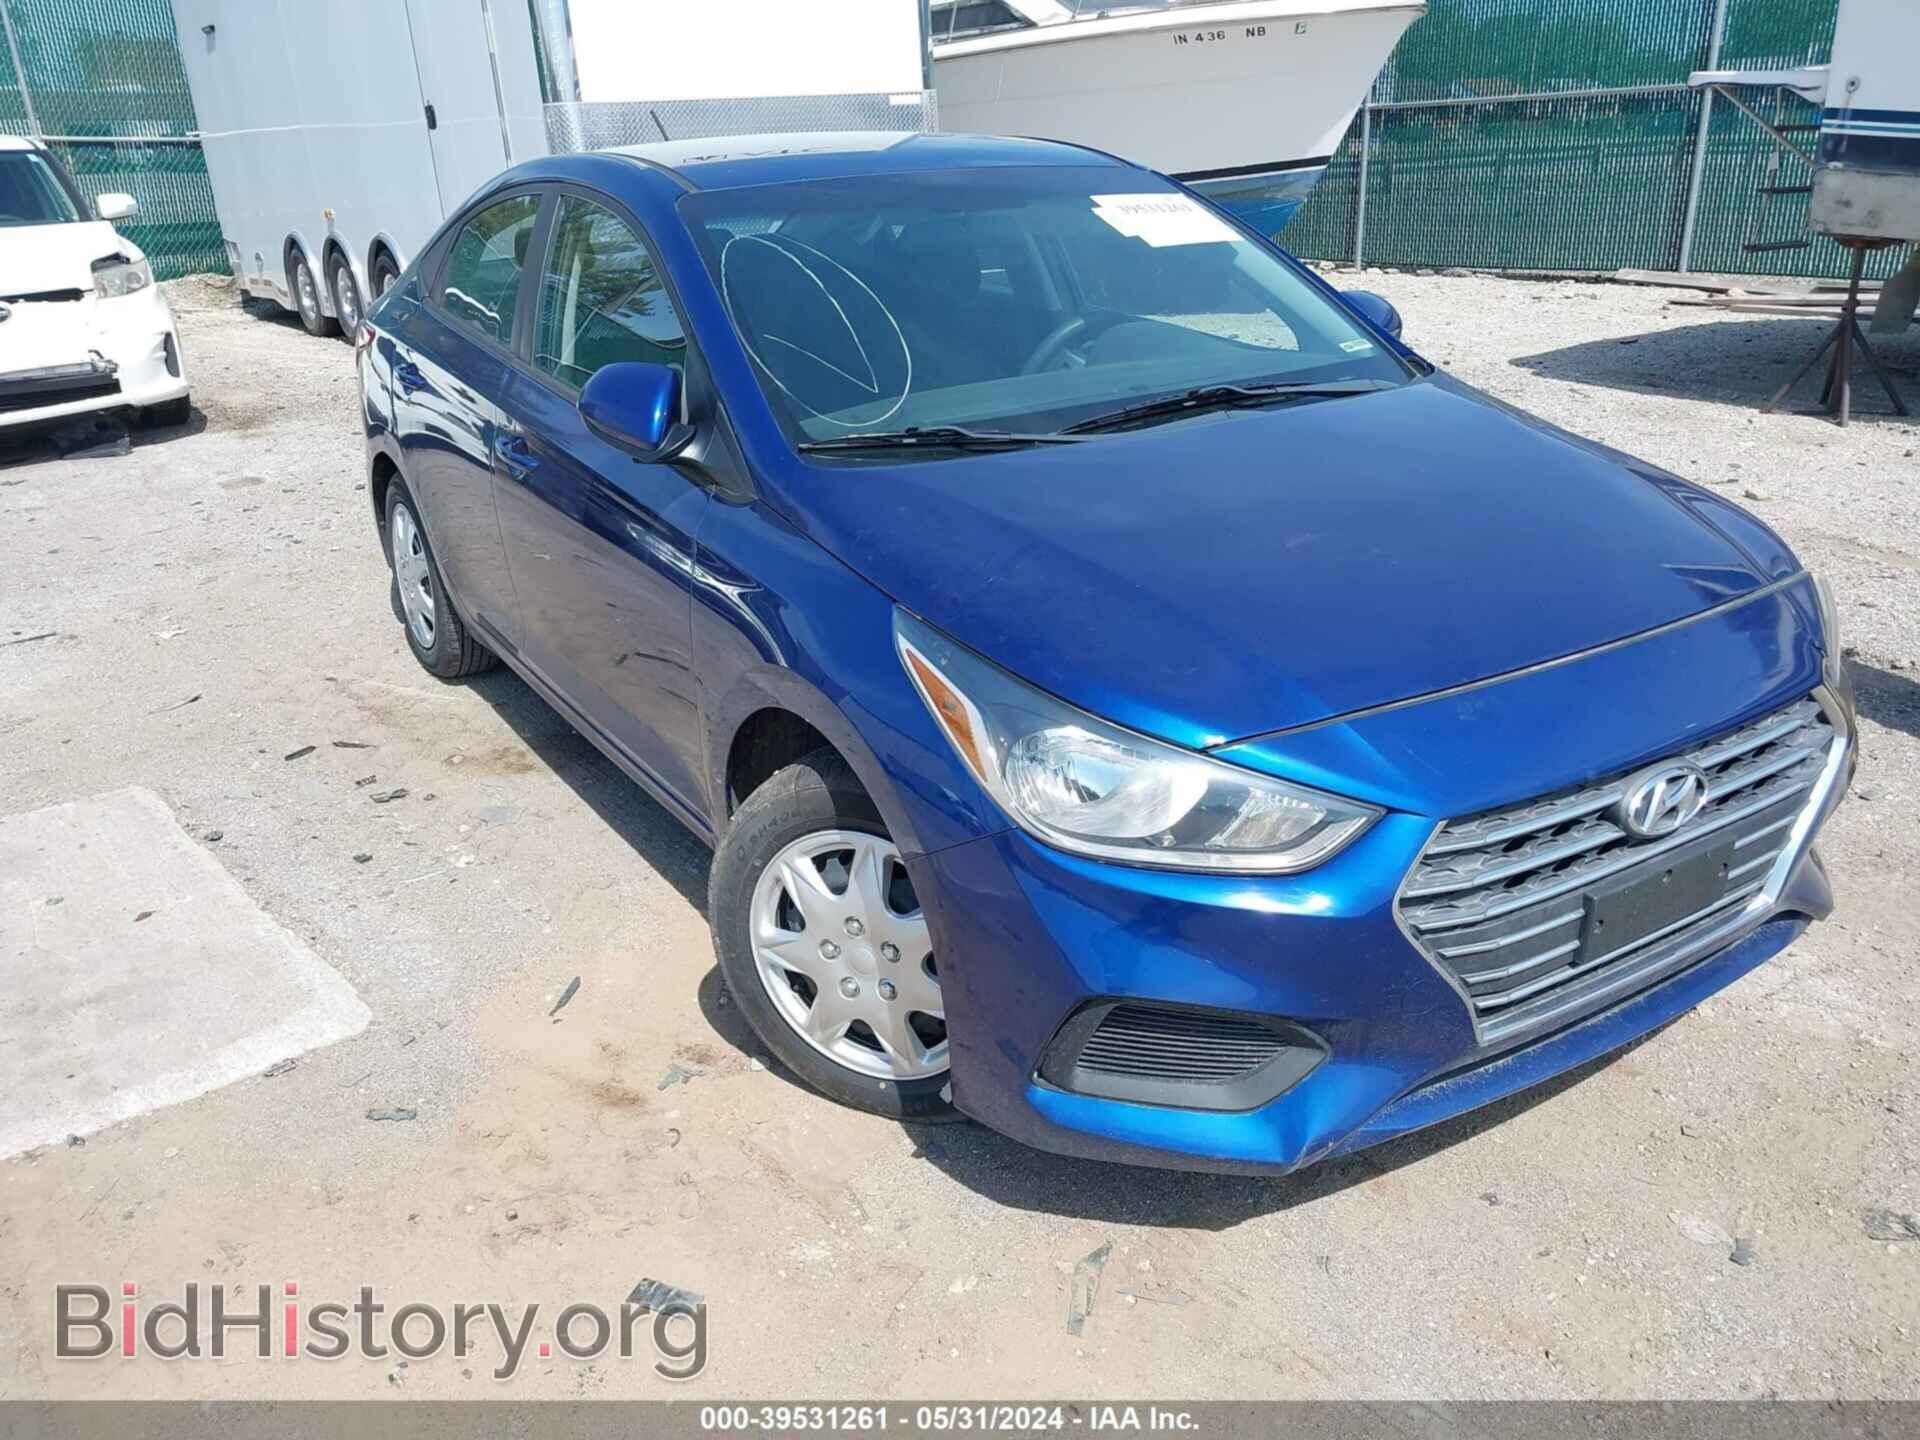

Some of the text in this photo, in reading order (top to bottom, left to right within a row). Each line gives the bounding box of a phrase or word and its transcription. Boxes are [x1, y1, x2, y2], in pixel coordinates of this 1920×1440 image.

[1173, 26, 1266, 45] IN 436 NB
